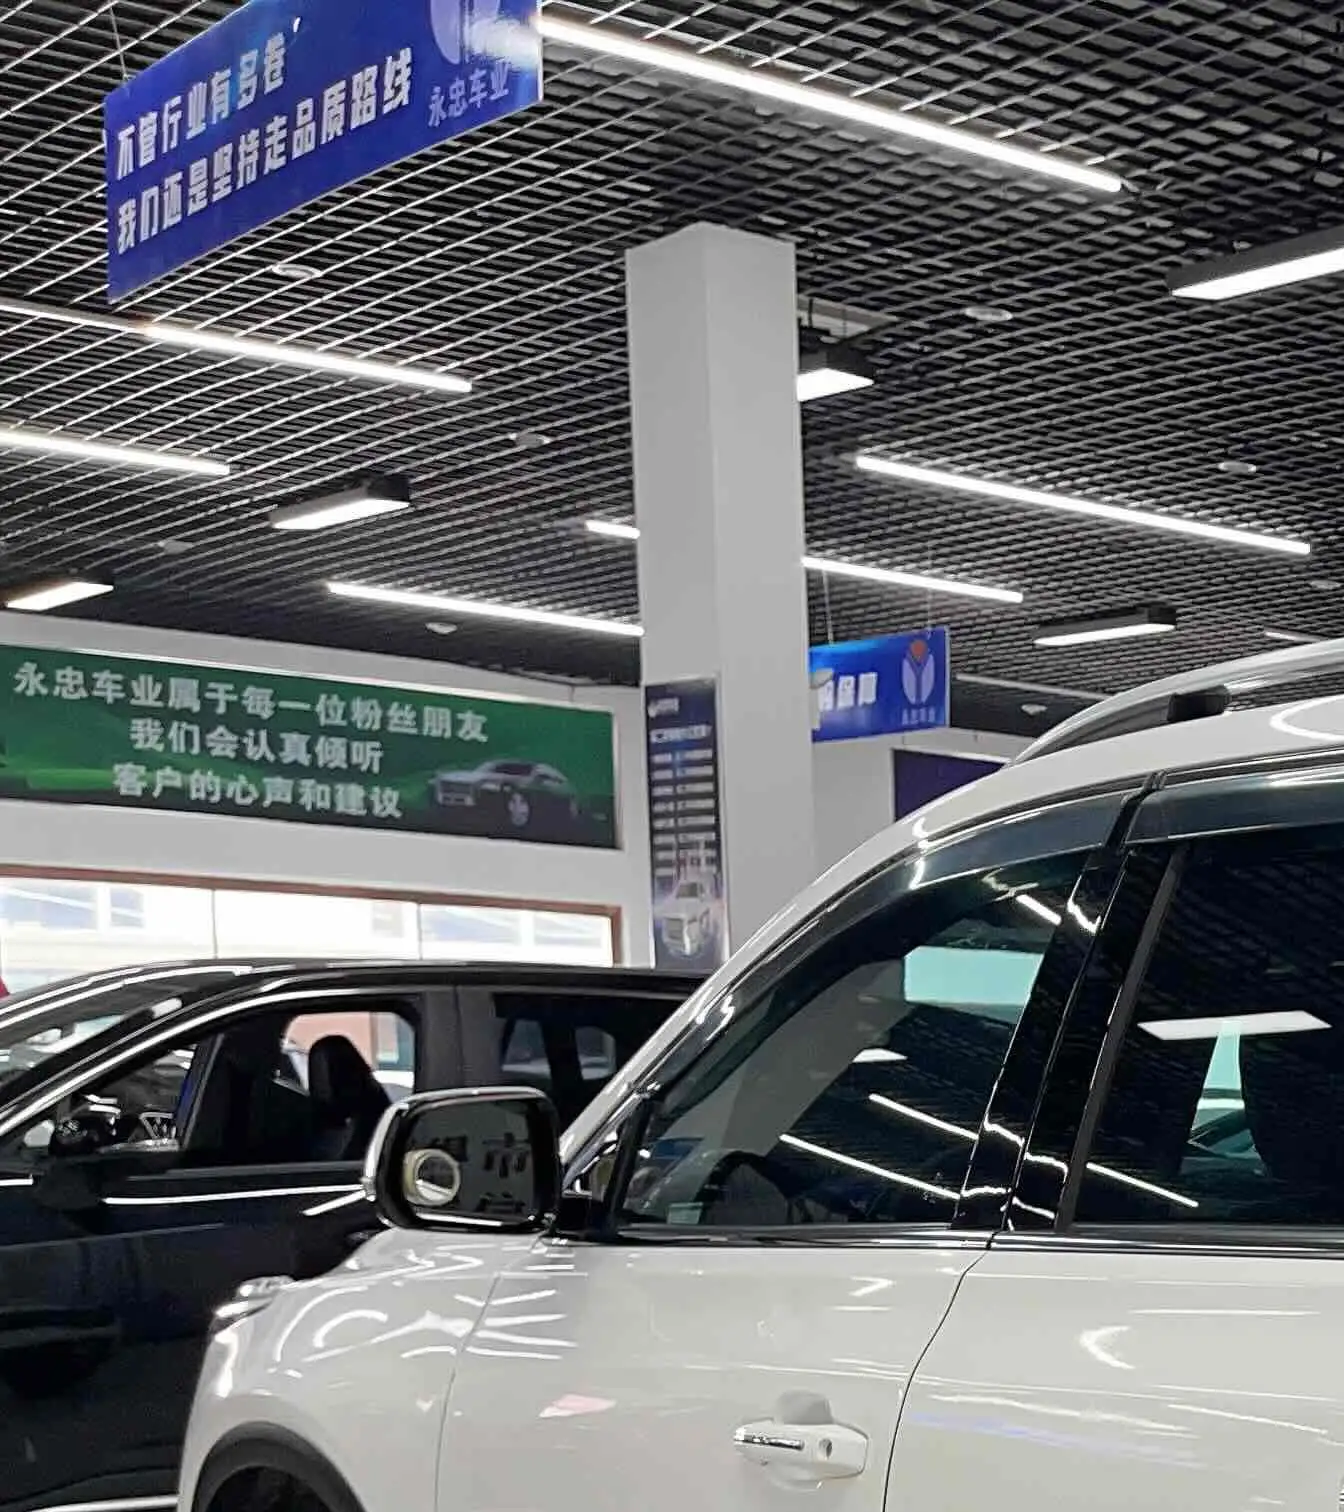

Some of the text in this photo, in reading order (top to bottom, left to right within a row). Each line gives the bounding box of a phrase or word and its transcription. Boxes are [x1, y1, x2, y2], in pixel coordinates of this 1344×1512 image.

[428, 61, 510, 127] 永忠车业
[117, 47, 412, 255] 我们还是坚持走品质路线
[13, 661, 489, 742] 永忠车业属于每一位粉丝朋友
[129, 717, 384, 774] 我们会认真倾听
[112, 761, 403, 819] 客户的心声和建议
